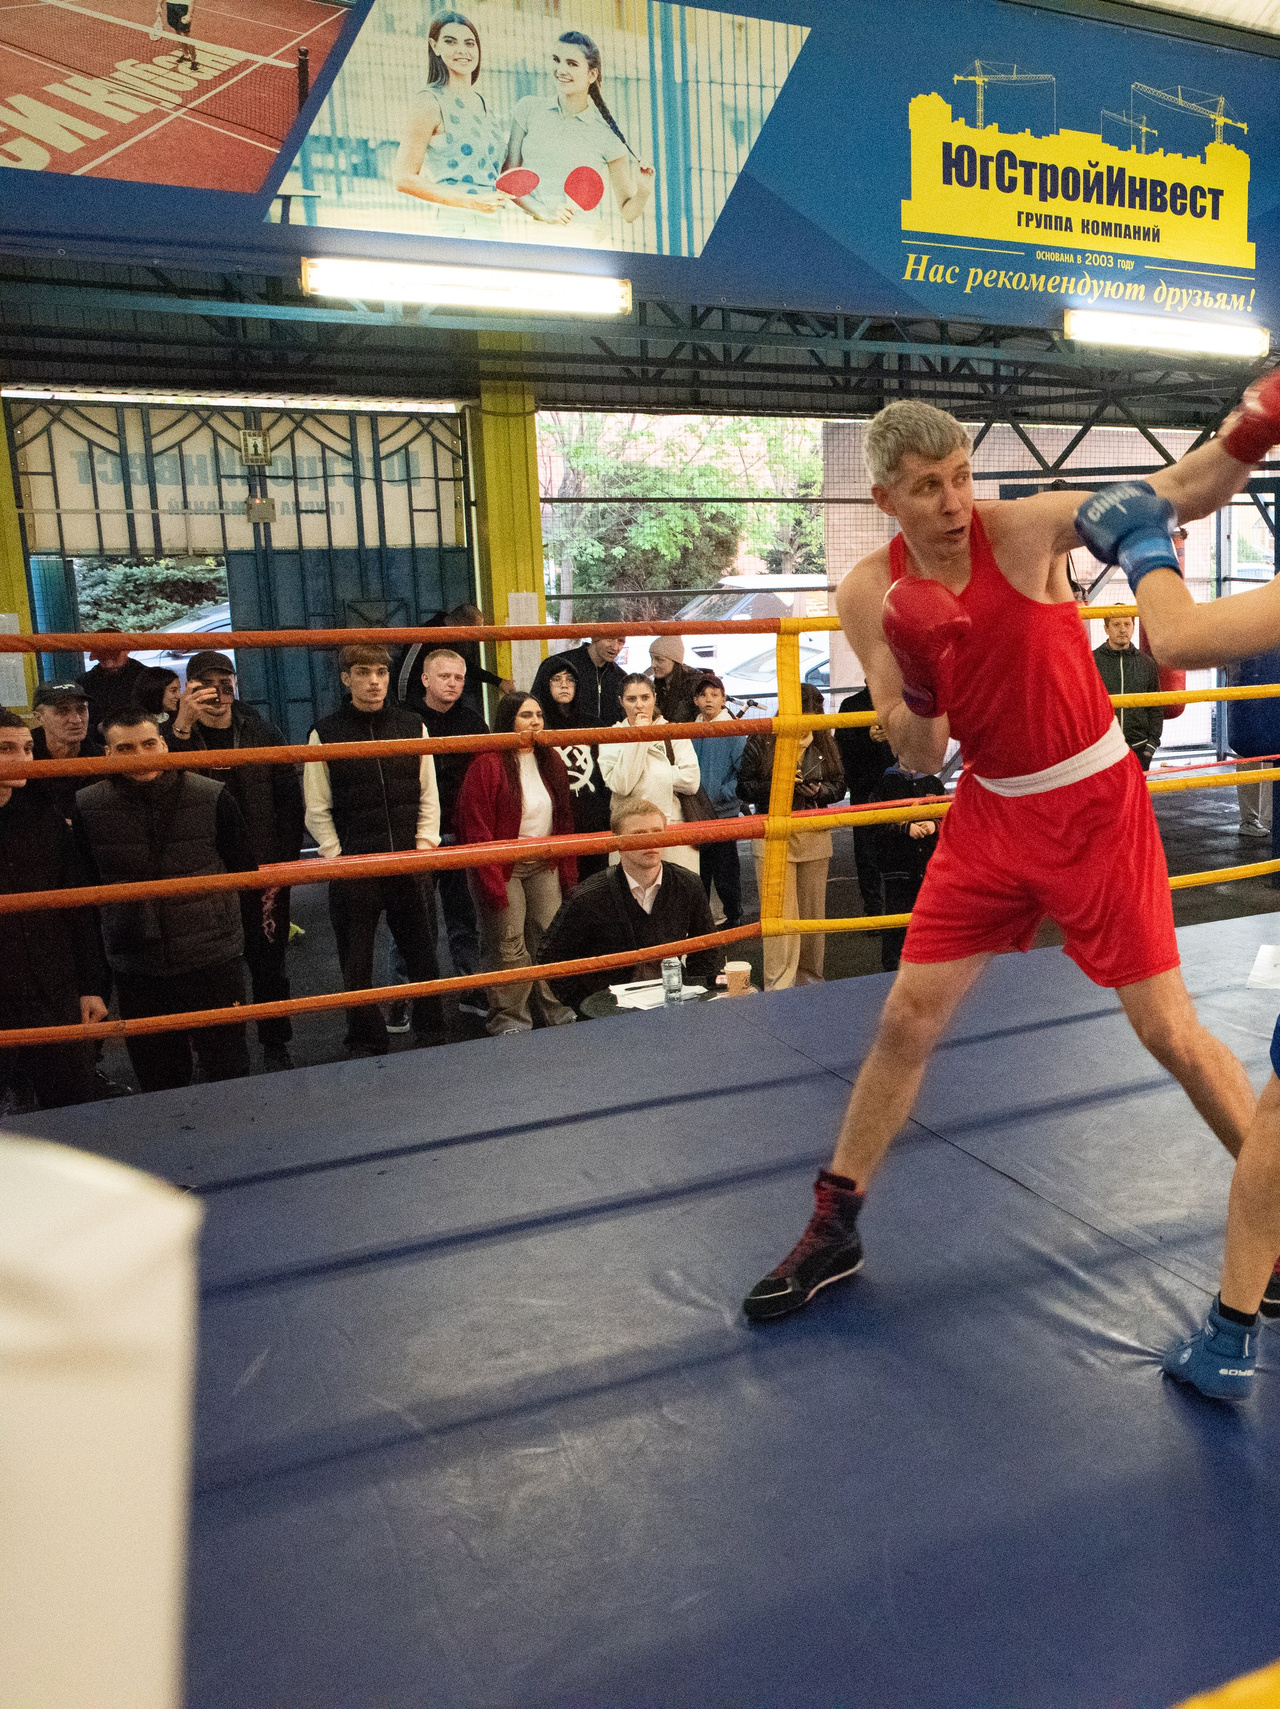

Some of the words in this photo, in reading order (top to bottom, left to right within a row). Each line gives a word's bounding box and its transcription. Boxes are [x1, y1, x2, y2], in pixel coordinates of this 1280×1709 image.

[942, 141, 1224, 221] ЮгСтройИнвест
[1016, 211, 1073, 233] ГРУППА
[1081, 218, 1161, 243] КОМПАНИЙ
[1036, 251, 1075, 263] ОСНОВАНА
[1077, 255, 1082, 264] В
[1085, 253, 1114, 267] 2003
[902, 253, 959, 284] Нас
[965, 266, 1146, 304] рекомендуют
[1153, 279, 1255, 312] друзьям!
